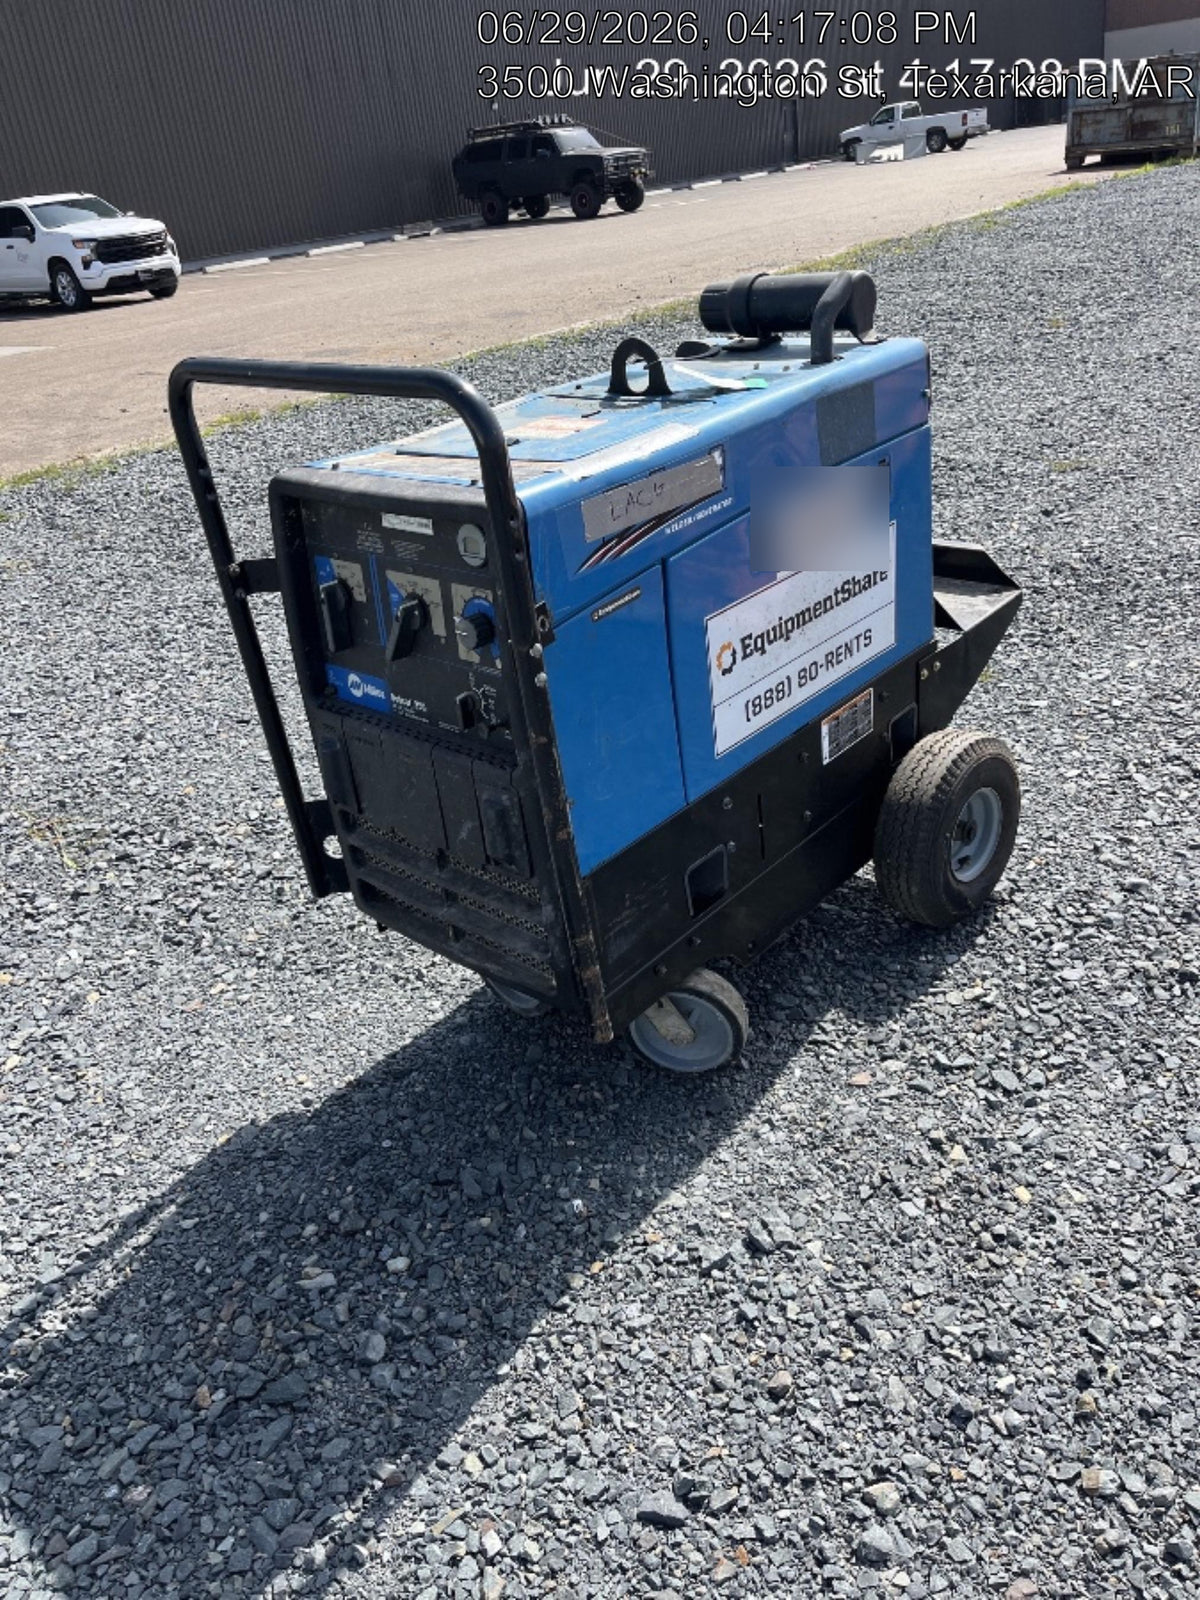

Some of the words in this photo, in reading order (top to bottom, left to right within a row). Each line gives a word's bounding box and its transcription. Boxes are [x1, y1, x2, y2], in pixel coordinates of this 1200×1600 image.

[740, 571, 888, 661] EquipmentShare
[744, 675, 792, 722] (888)
[798, 628, 873, 688] 80-RENTS
